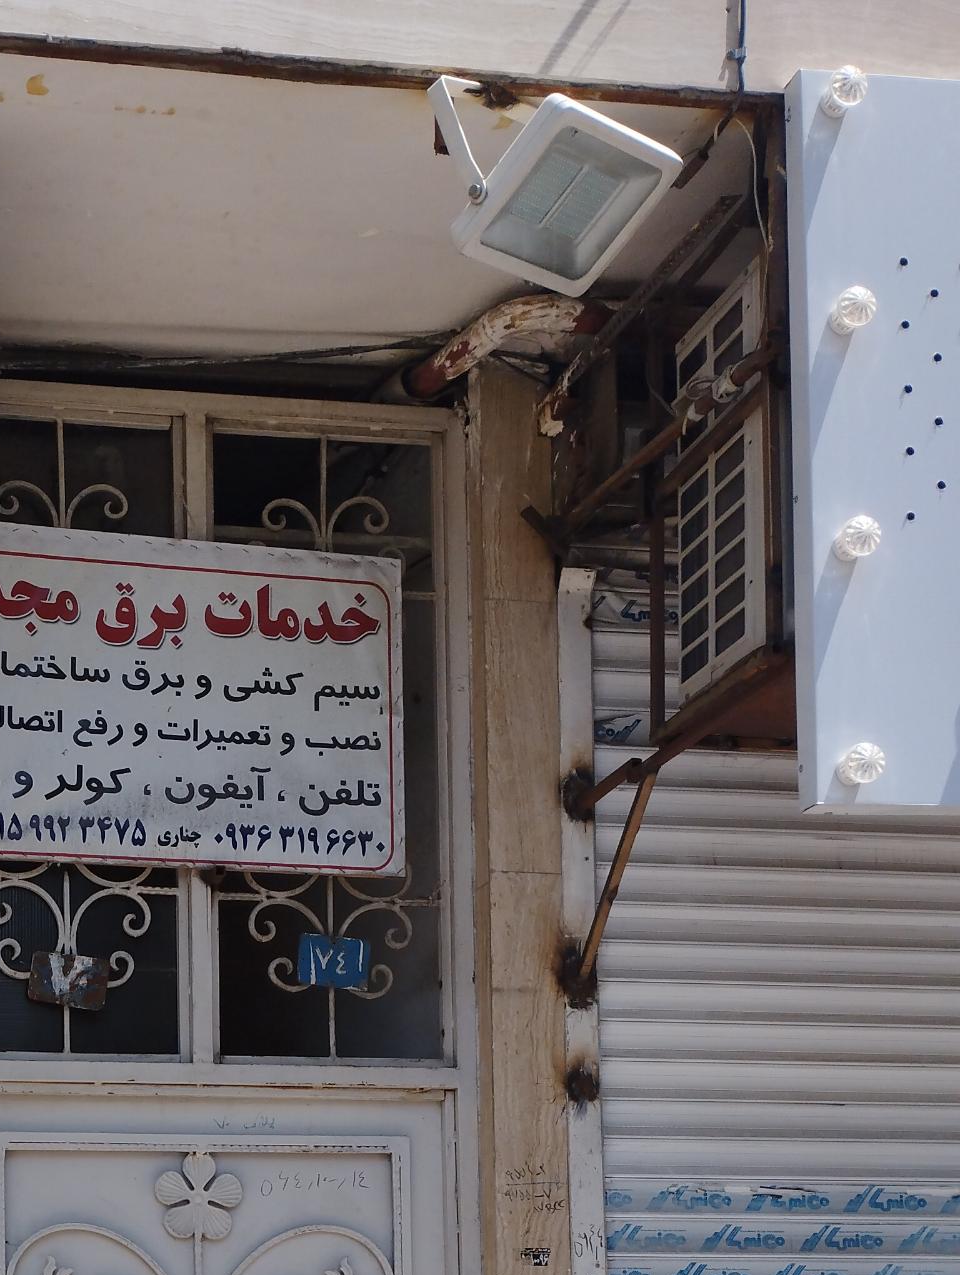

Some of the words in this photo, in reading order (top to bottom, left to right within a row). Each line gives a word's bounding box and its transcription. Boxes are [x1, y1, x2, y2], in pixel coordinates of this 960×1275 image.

[96, 581, 189, 648] برق
[204, 584, 381, 645] خدمات
[121, 659, 185, 696] برق
[195, 673, 212, 699] و
[223, 668, 304, 702] کشی
[314, 681, 381, 711] سیم
[72, 709, 125, 747] رفع
[133, 721, 149, 746] و
[157, 719, 272, 751] تعمیرات
[280, 729, 296, 755] و
[305, 732, 382, 757] نصب
[14, 769, 34, 797] و
[44, 765, 131, 805] کولر
[157, 826, 202, 848] چناری
